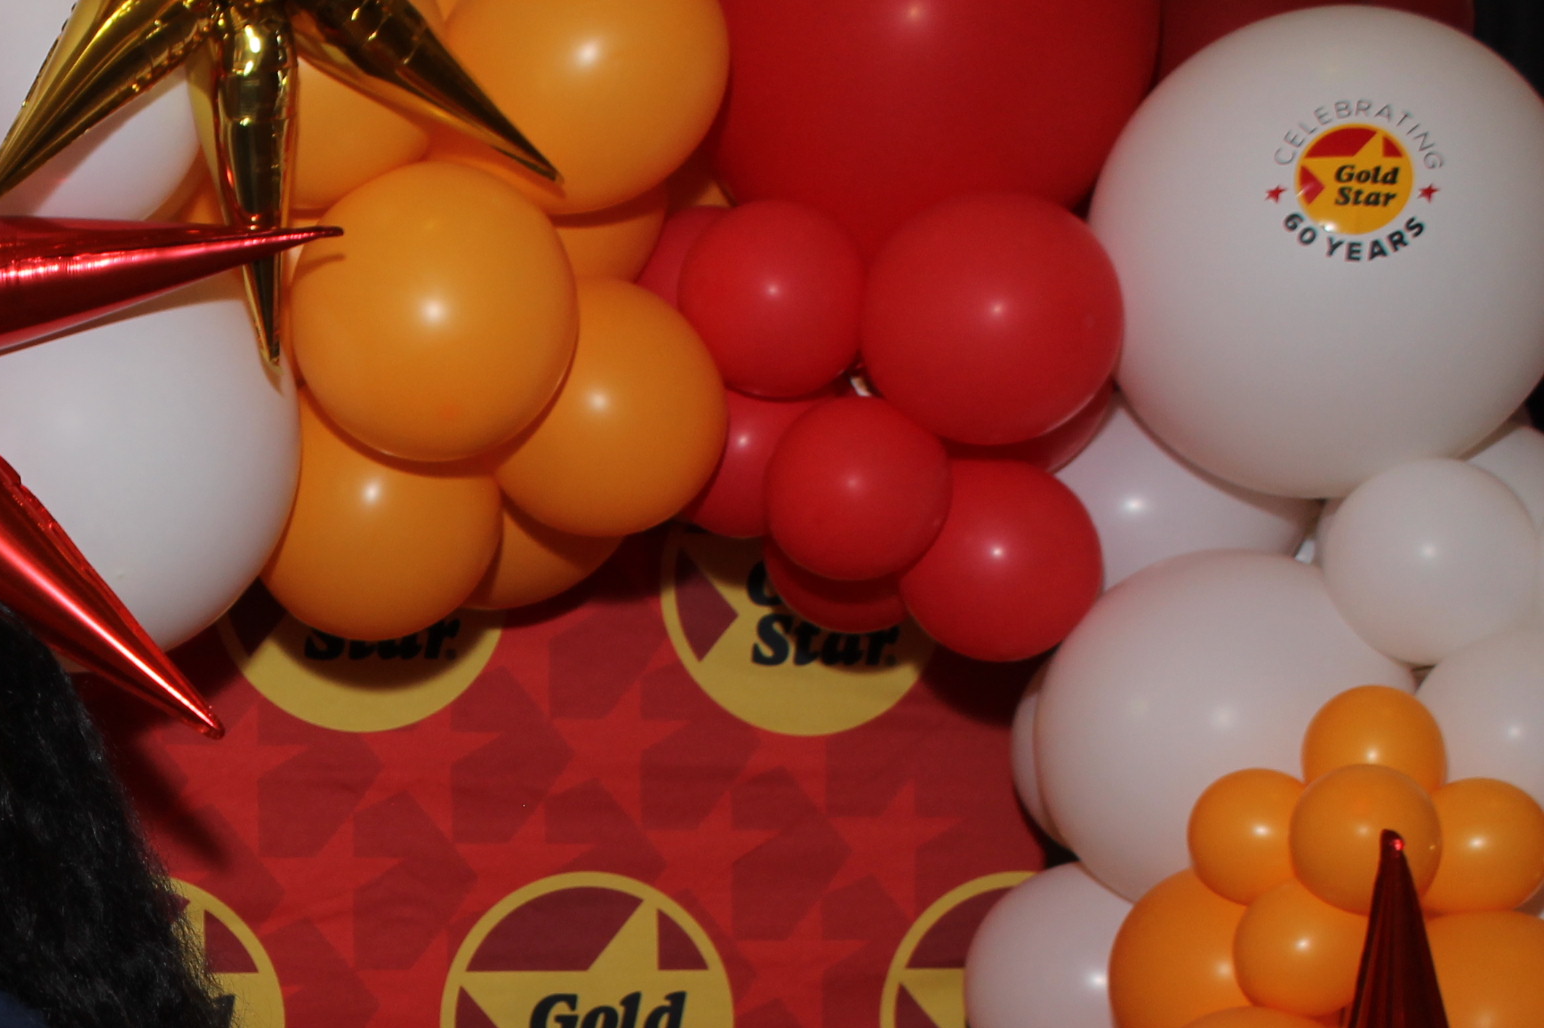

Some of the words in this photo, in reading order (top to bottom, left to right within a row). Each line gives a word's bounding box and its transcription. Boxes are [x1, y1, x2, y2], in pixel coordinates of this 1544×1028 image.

[1273, 98, 1445, 171] CELEBRATING
[1333, 164, 1401, 185] Gold
[1333, 186, 1398, 207] Star
[1283, 212, 1319, 246] 60
[1325, 216, 1426, 262] YEARS
